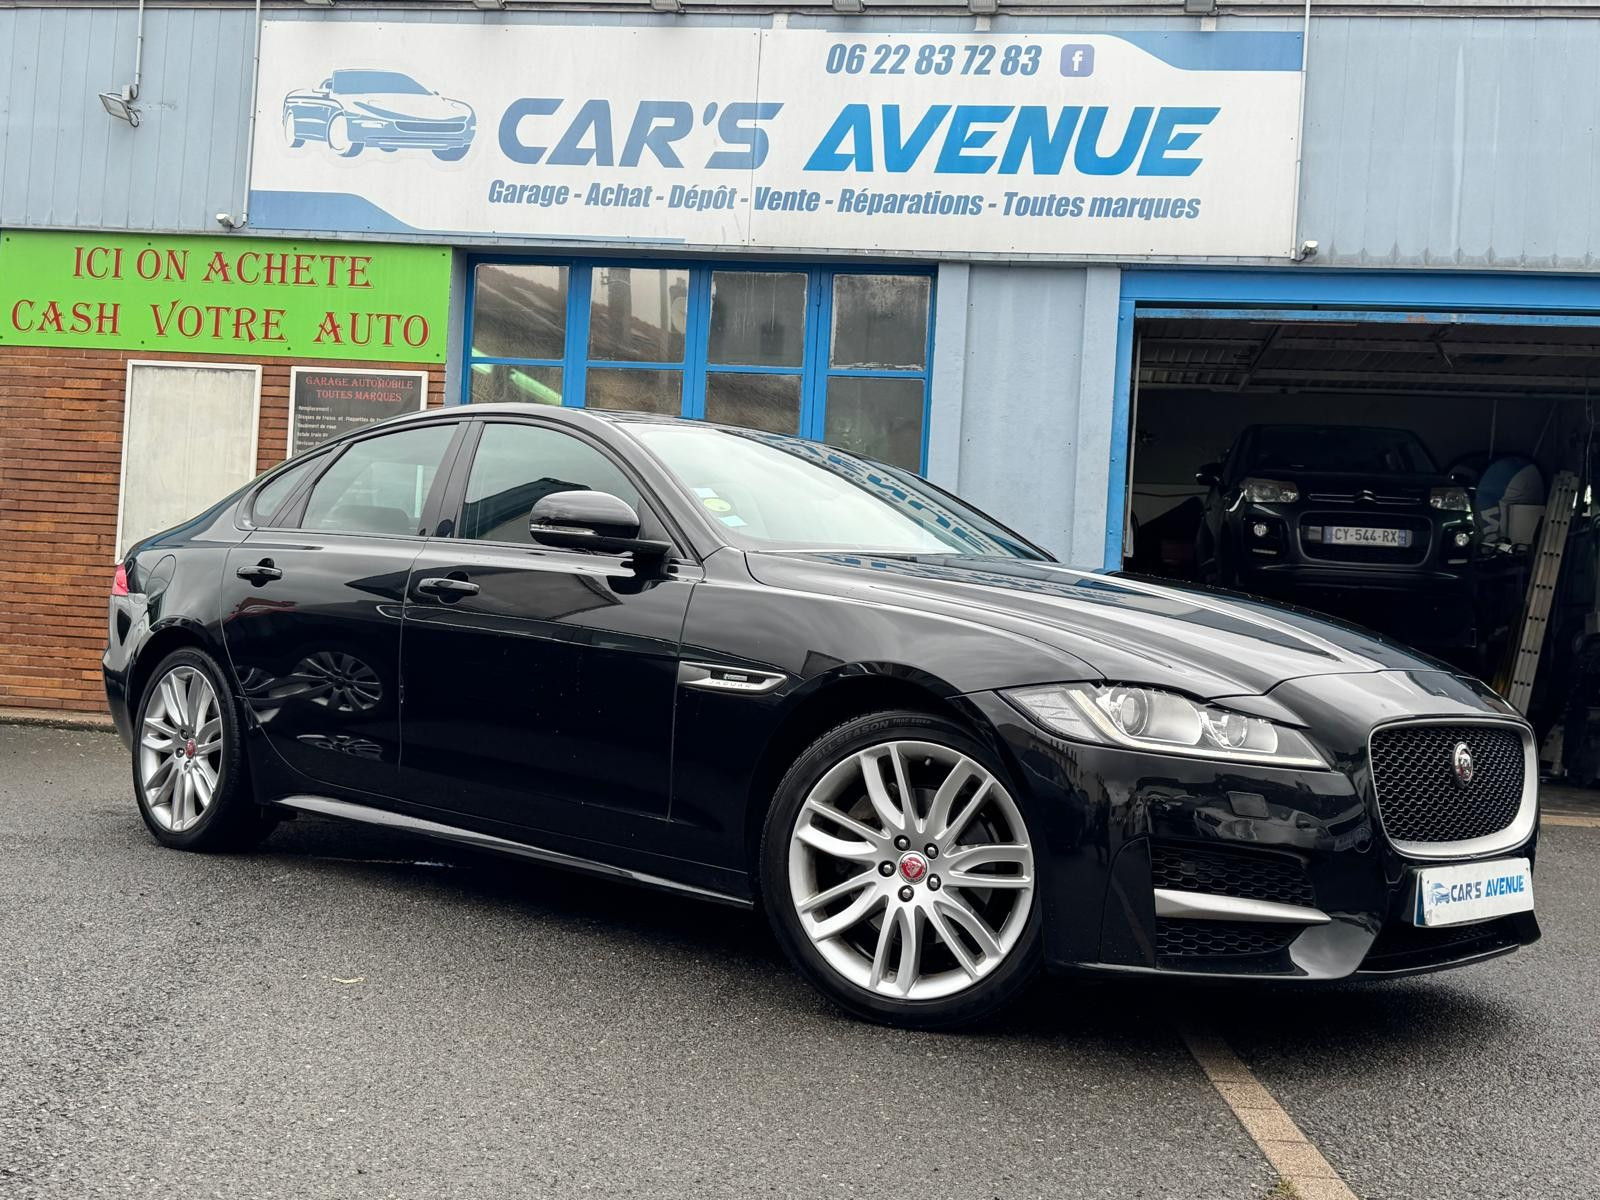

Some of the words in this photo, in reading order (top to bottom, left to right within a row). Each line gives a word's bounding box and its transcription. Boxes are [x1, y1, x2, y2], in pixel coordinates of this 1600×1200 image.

[825, 43, 867, 75] 06
[870, 44, 911, 75] 22
[914, 45, 956, 76] 83
[960, 45, 997, 76] 72
[1000, 45, 1042, 76] 83
[498, 97, 785, 170] CAR'S
[802, 103, 1222, 177] AVENUE
[488, 179, 570, 206] Garage
[585, 182, 653, 208] Achat
[668, 184, 738, 212] Dépôt
[754, 186, 821, 212] Vente
[837, 188, 984, 216] Réparations
[1002, 191, 1085, 218] Toutes
[1088, 196, 1202, 221] marques
[72, 247, 124, 280] ICI
[136, 248, 190, 281] ON
[201, 251, 374, 289] ACHETE
[11, 299, 122, 336] CASH
[150, 298, 288, 343] VOTRE
[312, 311, 431, 348] AUTO
[305, 376, 348, 386] GARAGE
[351, 378, 414, 390] AUTOMOBILE
[316, 389, 353, 400] TOUTES
[354, 391, 402, 402] MARQUES
[1334, 528, 1397, 543] CY-544-RX
[1450, 881, 1482, 902] CAR'S
[1485, 874, 1526, 898] AVENUE
